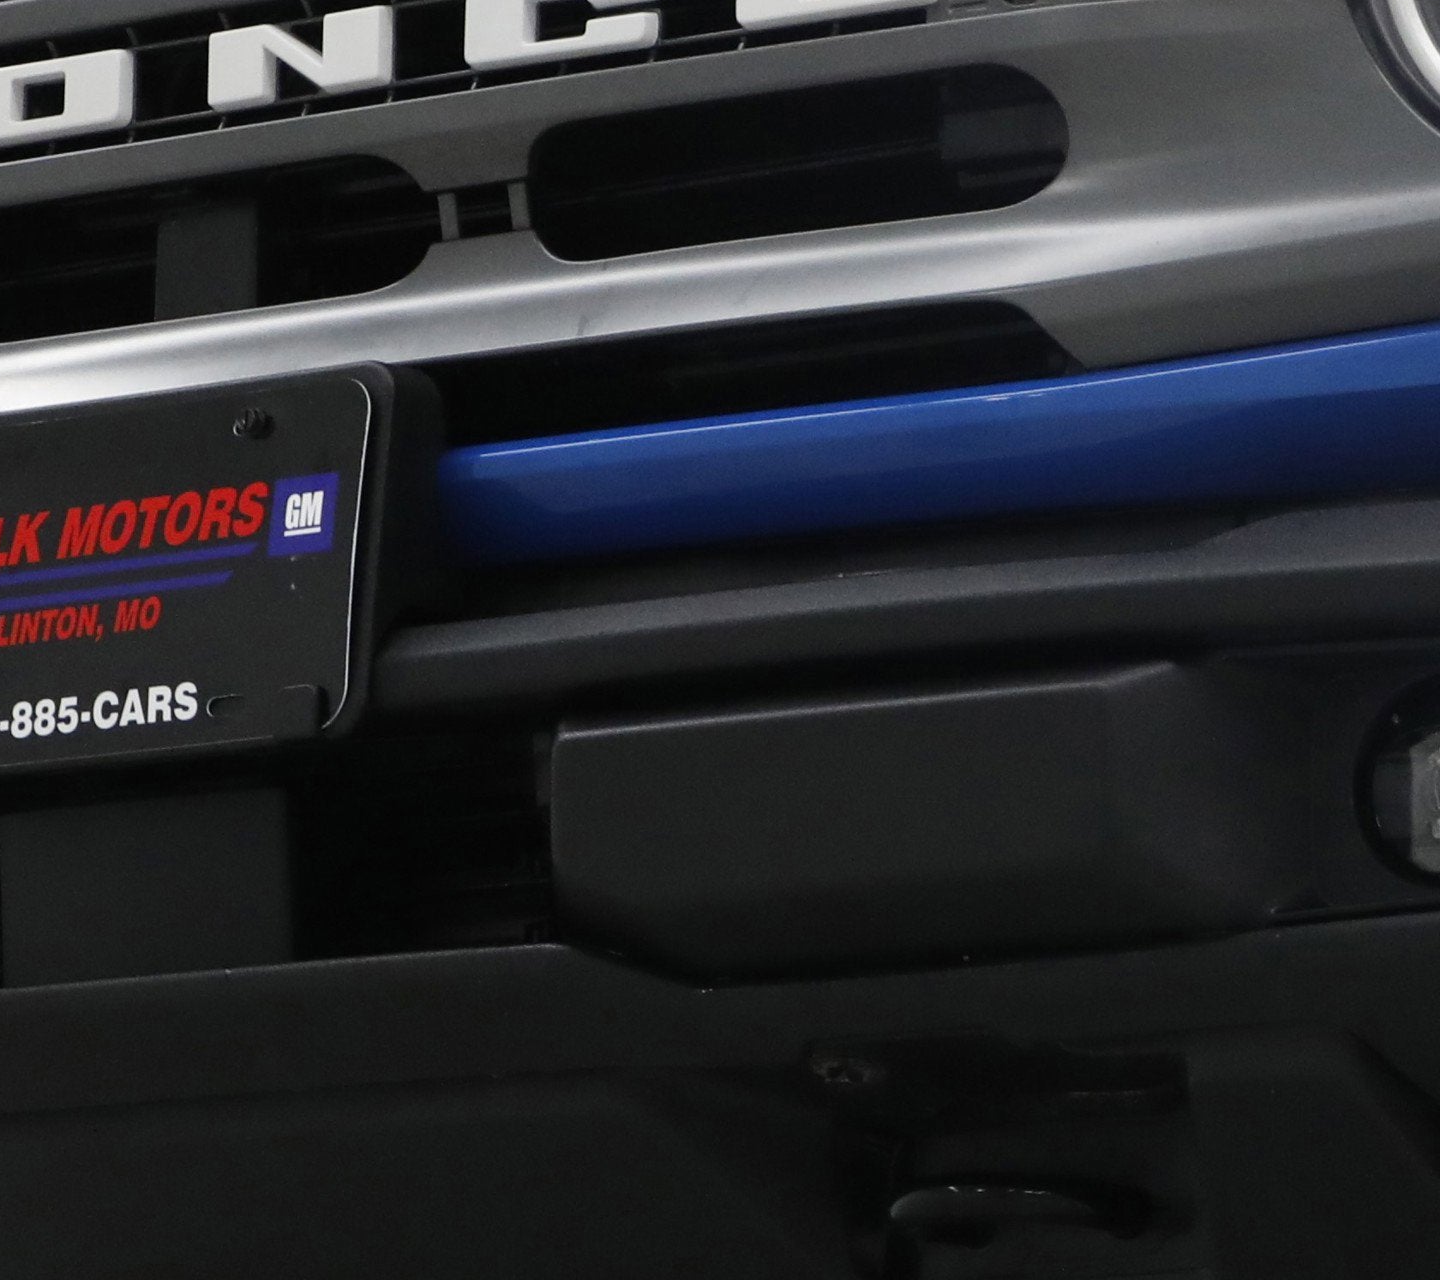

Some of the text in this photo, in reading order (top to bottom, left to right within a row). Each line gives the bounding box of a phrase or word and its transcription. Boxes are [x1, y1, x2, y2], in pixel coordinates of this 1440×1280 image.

[55, 480, 271, 560] MOTORS
[283, 490, 326, 531] GM
[113, 595, 162, 632] MO
